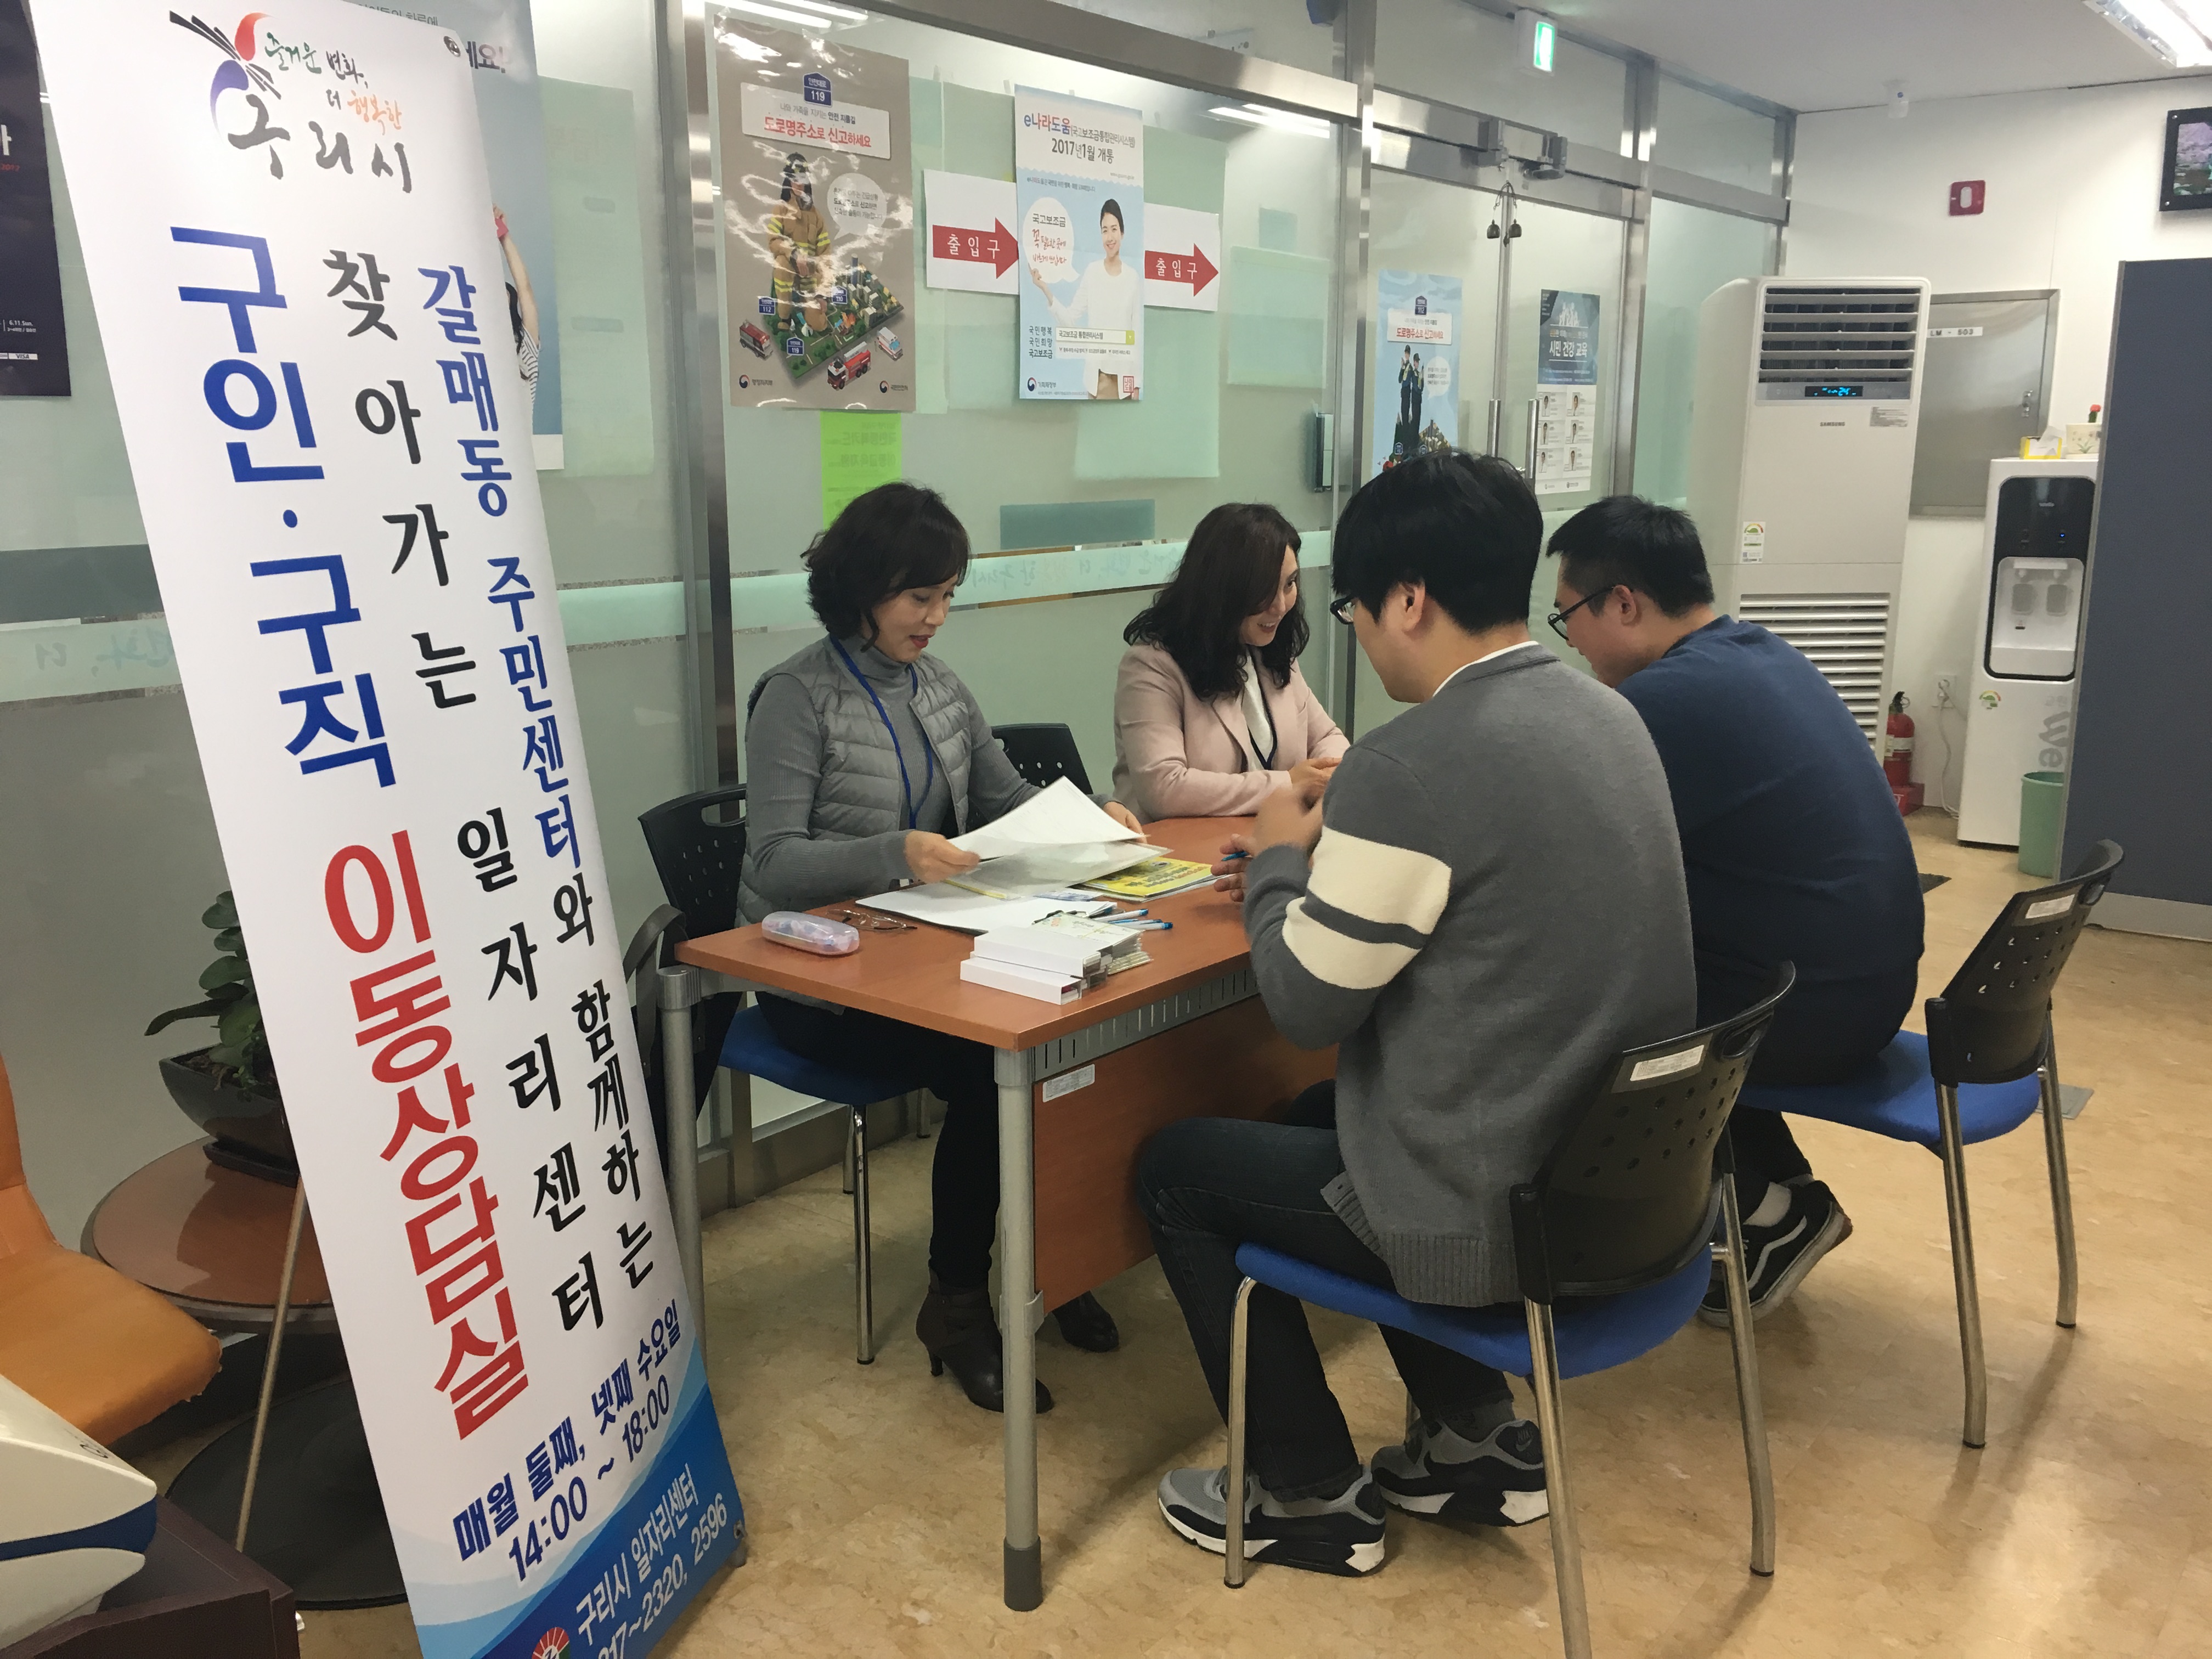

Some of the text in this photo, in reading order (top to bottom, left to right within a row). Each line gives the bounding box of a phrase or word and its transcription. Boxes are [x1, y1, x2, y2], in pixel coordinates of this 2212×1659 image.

[266, 32, 369, 88] 즐거운 변화,
[327, 89, 403, 135] 더 행복한
[811, 91, 825, 101] 119
[828, 111, 839, 121] 안전
[228, 94, 412, 193] 구리시
[764, 116, 871, 147] 도로명주소로 신고하세요
[1052, 138, 1114, 164] 2017년1월 개통
[947, 234, 1001, 259] 출입구
[1032, 213, 1066, 227] 국고보조금
[1032, 229, 1040, 249] 꼭
[1155, 258, 1198, 279] 출입구
[1029, 349, 1053, 359] 국고보조금
[1549, 340, 1588, 358] 시민 건강 교육
[417, 265, 512, 517] 갈매동
[323, 250, 476, 709] 찾아가는
[488, 556, 595, 946] 주민센터와
[458, 807, 604, 1331] 일자리센터
[325, 830, 528, 1440] 이동상담실
[571, 979, 654, 1289] 함께하는
[453, 1299, 681, 1561] 매월 둘째, 넷째 수요일
[509, 1476, 587, 1582] 14:00
[622, 1374, 670, 1462] 18:00
[577, 1463, 699, 1646] 구리시 일자리센터
[691, 1493, 727, 1566] 2596
